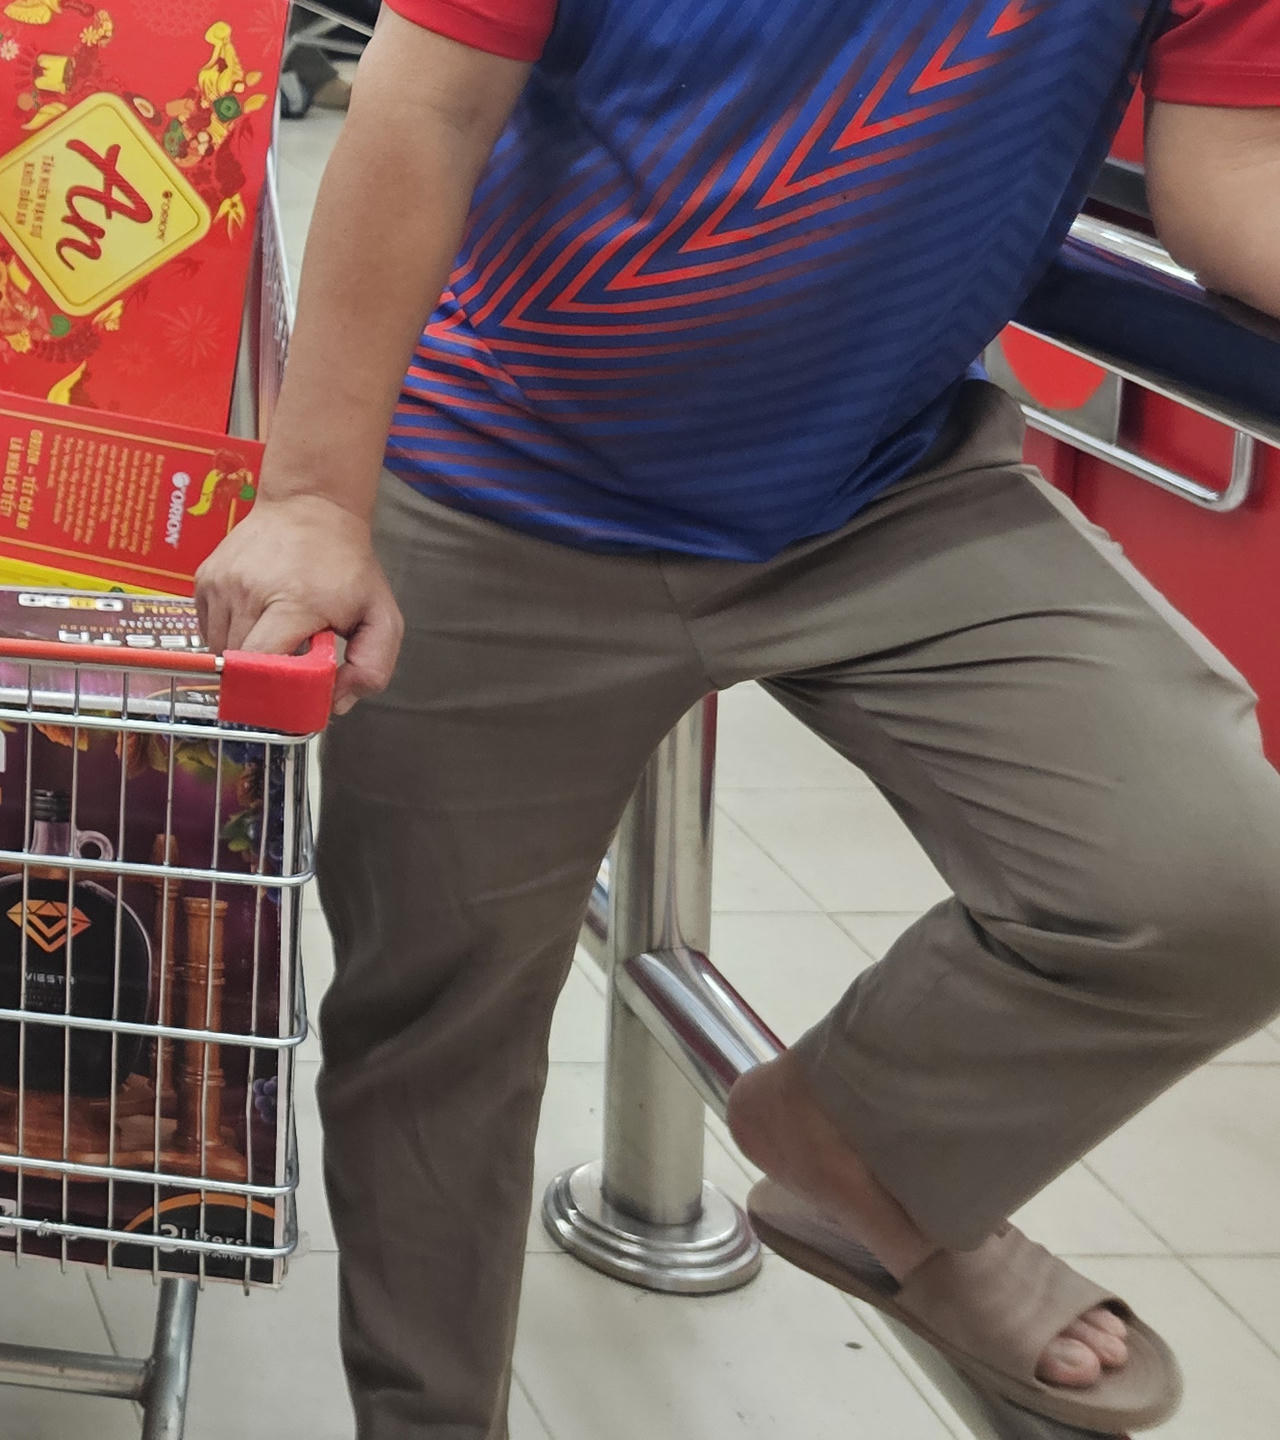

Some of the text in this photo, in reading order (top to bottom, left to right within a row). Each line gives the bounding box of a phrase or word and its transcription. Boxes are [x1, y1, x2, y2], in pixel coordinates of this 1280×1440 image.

[56, 138, 153, 271] An
[164, 489, 185, 549] ORION
[159, 1223, 179, 1253] 3
